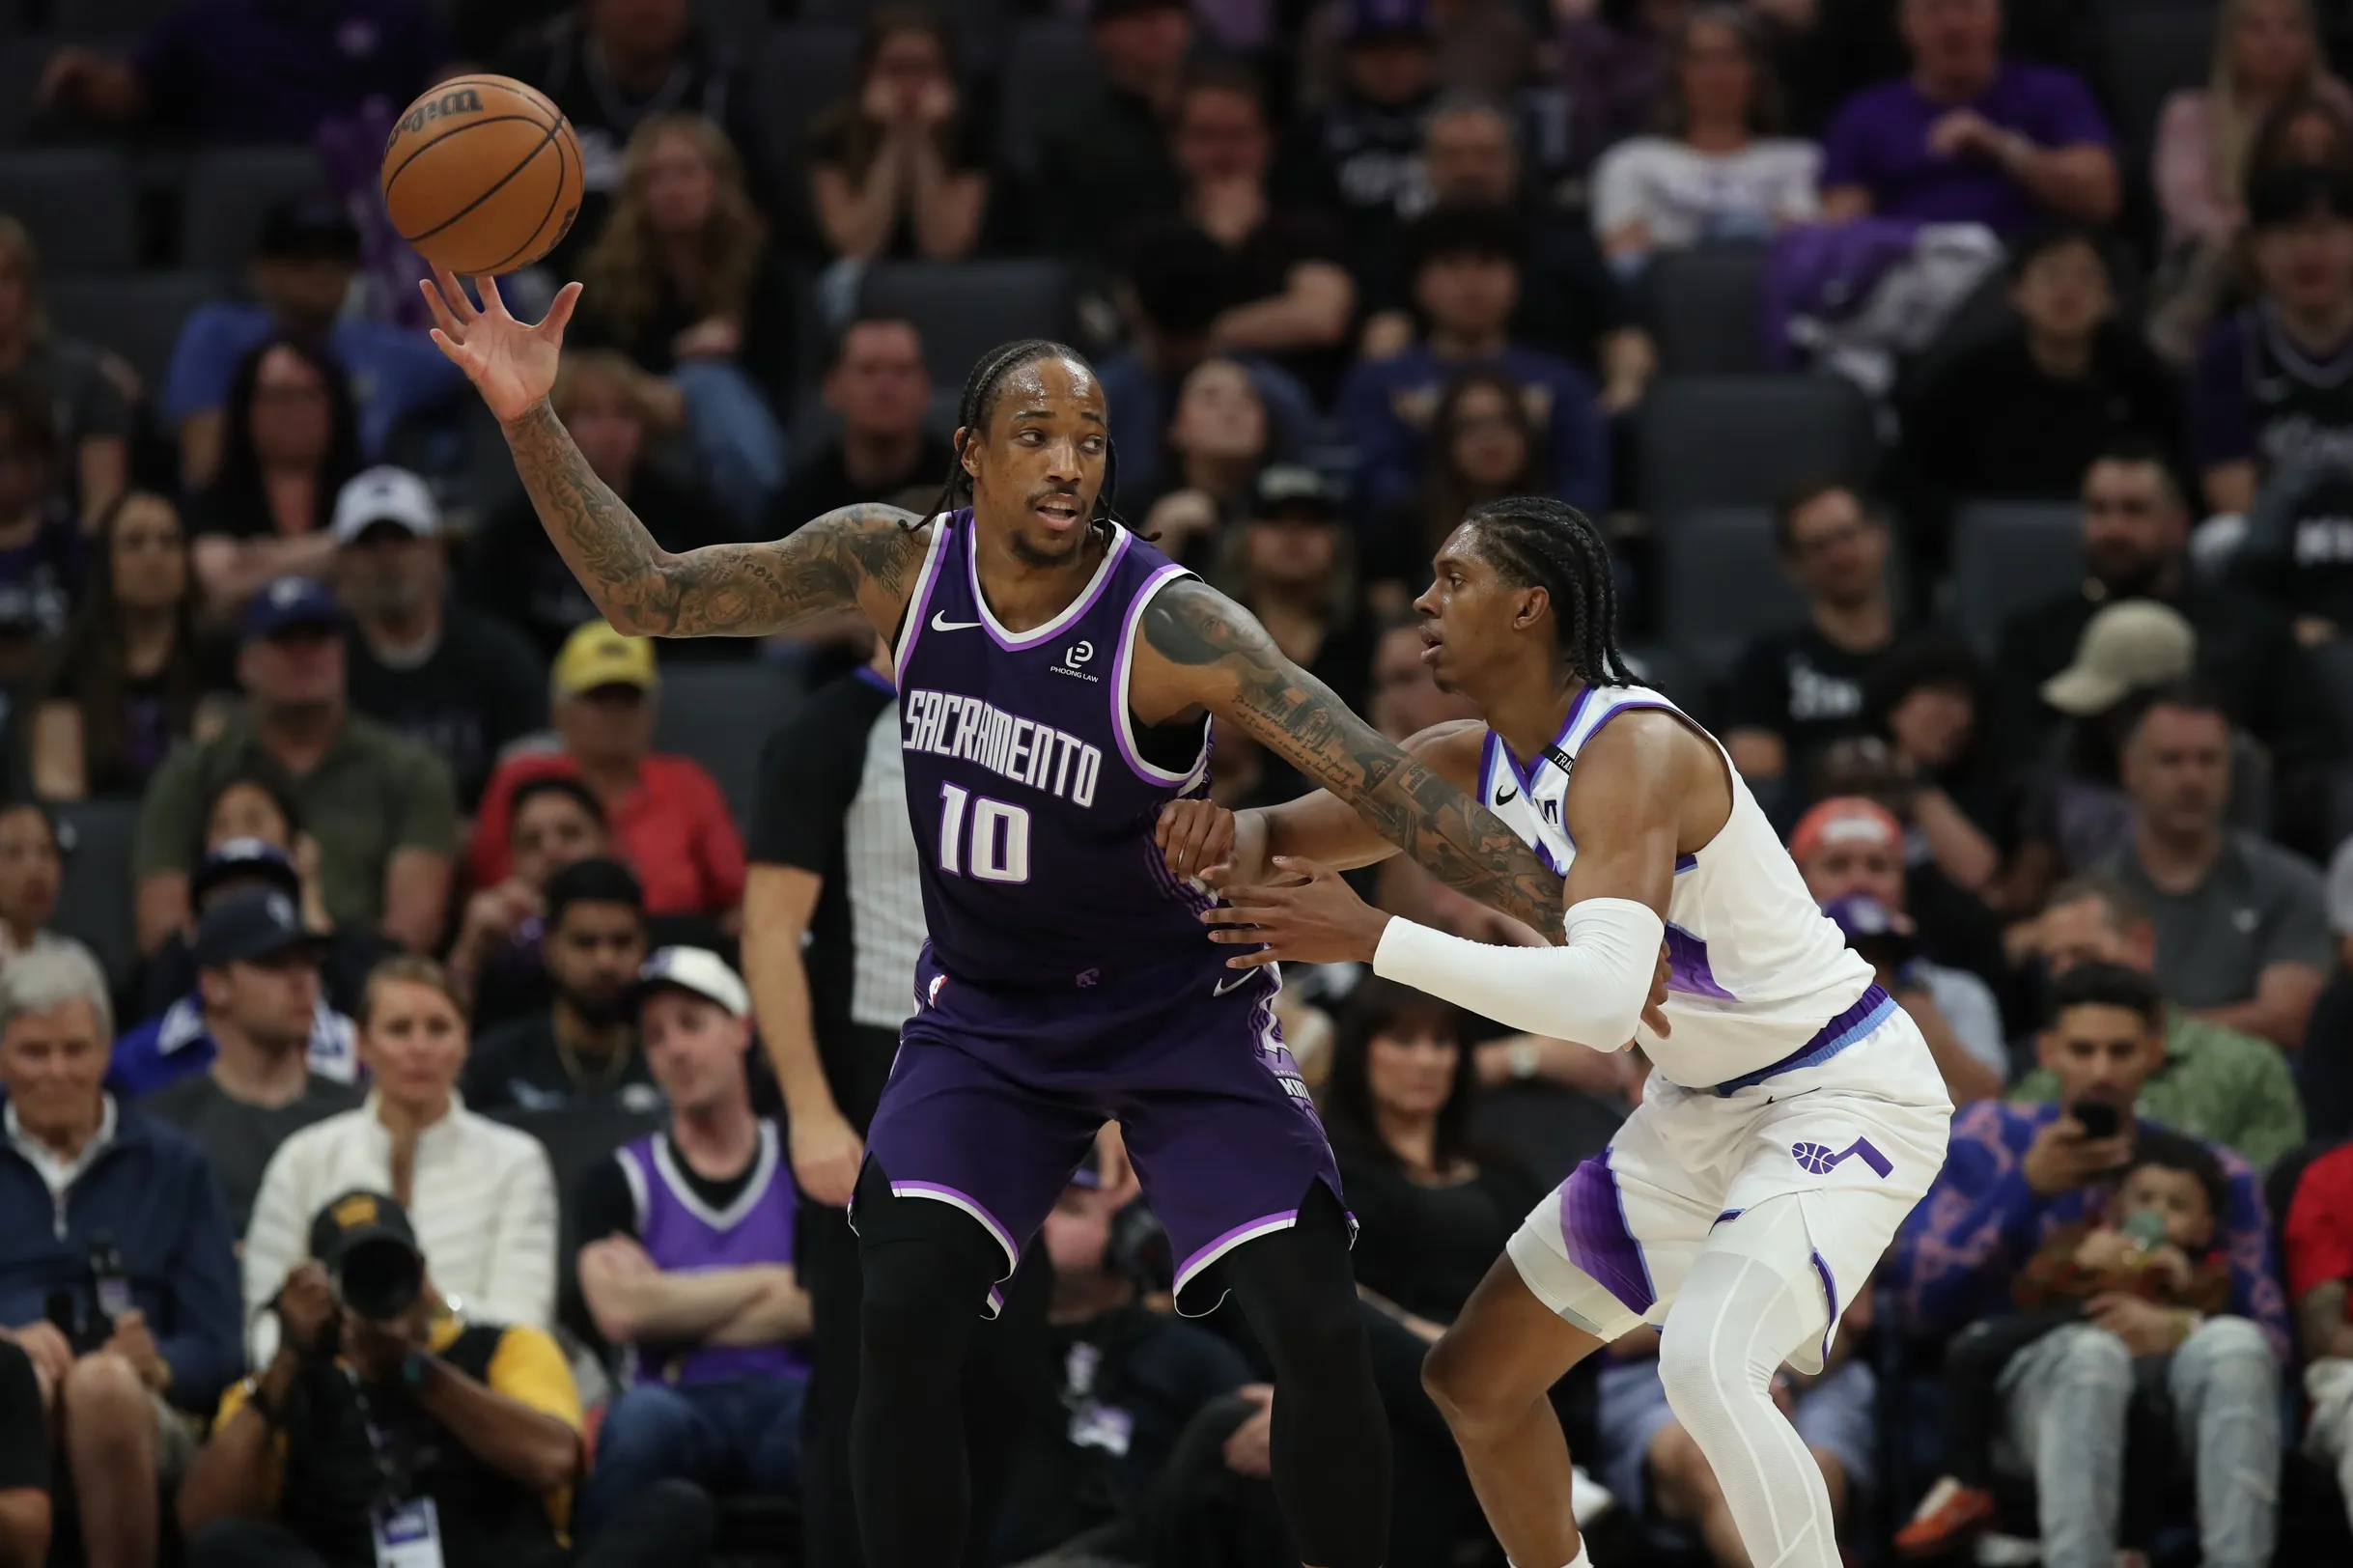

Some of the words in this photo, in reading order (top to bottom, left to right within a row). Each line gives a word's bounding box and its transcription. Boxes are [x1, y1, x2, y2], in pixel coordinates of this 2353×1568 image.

[383, 89, 484, 152] Wilso
[1050, 665, 1082, 679] PHOONG
[1082, 673, 1099, 683] LAW
[902, 689, 1102, 808] SACRAMENTO
[939, 780, 1031, 884] 10
[1277, 1078, 1313, 1104] KIN
